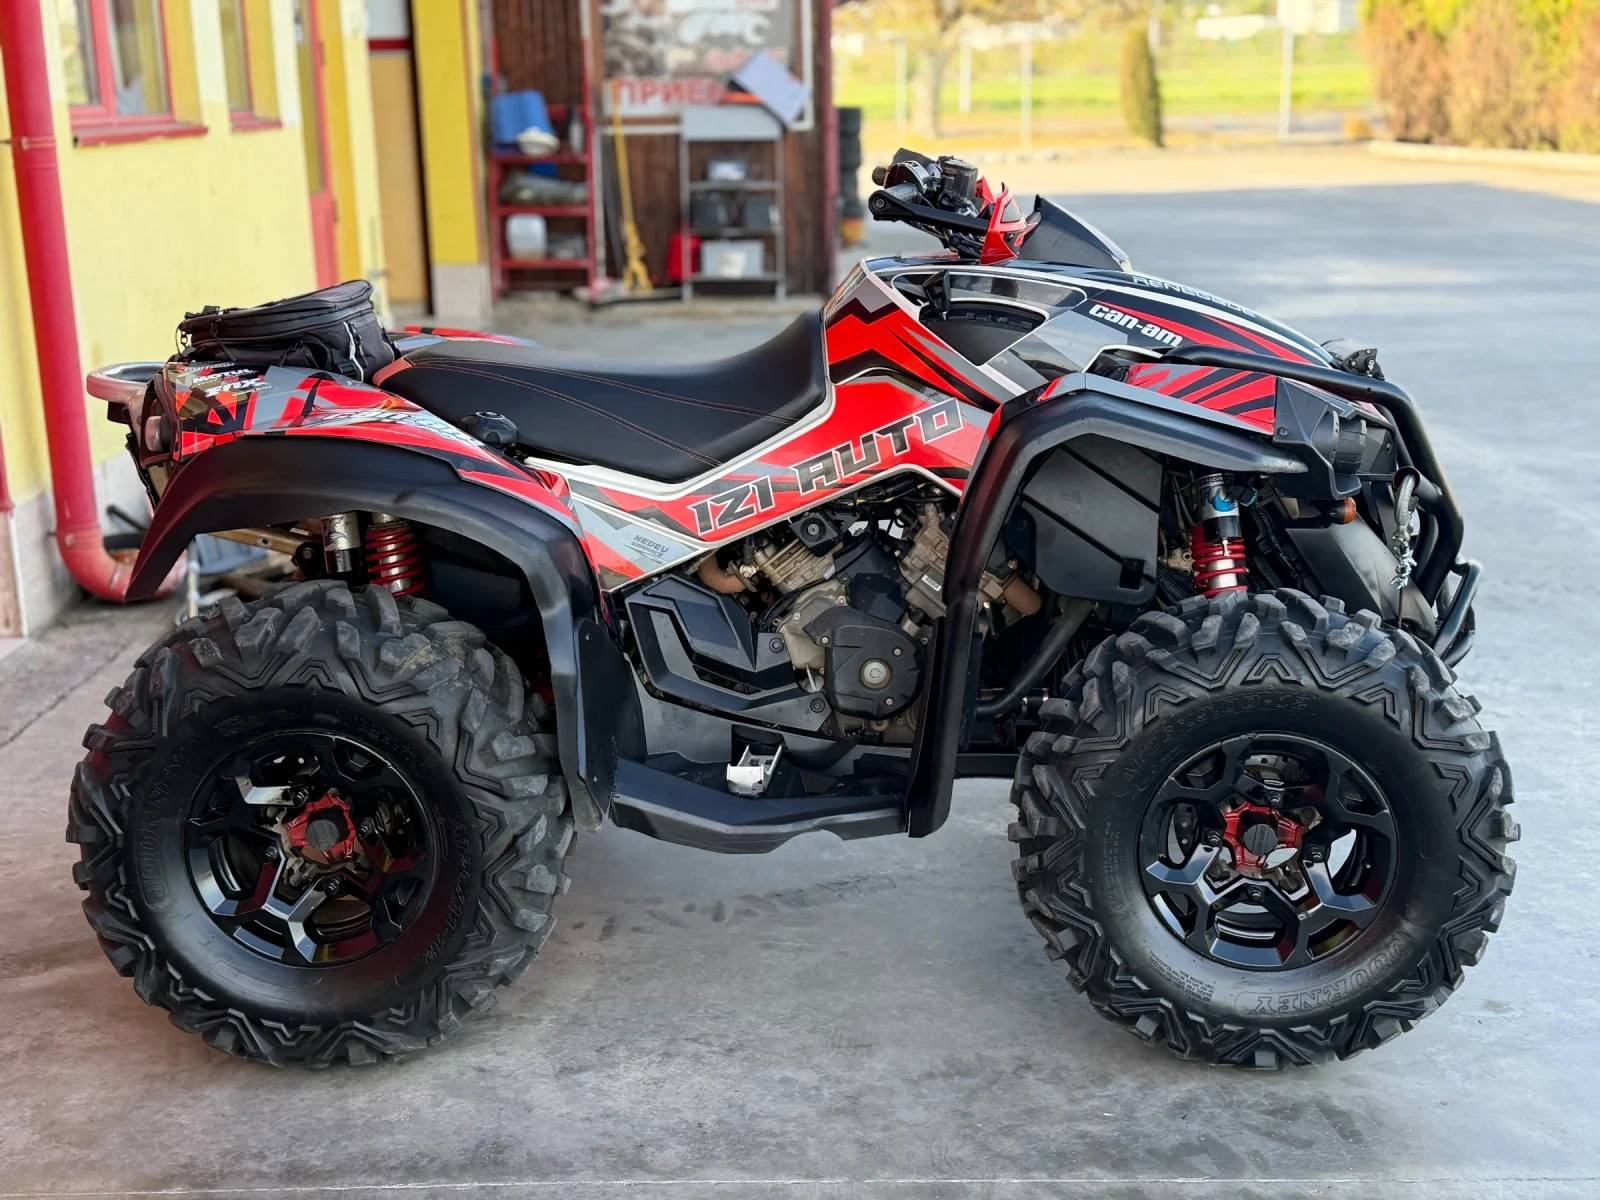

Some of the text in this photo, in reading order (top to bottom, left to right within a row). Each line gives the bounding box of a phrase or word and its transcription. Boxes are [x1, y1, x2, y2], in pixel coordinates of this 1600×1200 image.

[1133, 276, 1256, 318] RENEGADE
[1089, 304, 1183, 348] can-am
[193, 369, 254, 384] MOTUL
[686, 397, 964, 537] IZI AUTO
[633, 534, 670, 553] NEDEV
[1247, 935, 1409, 1015] JOURNEY
